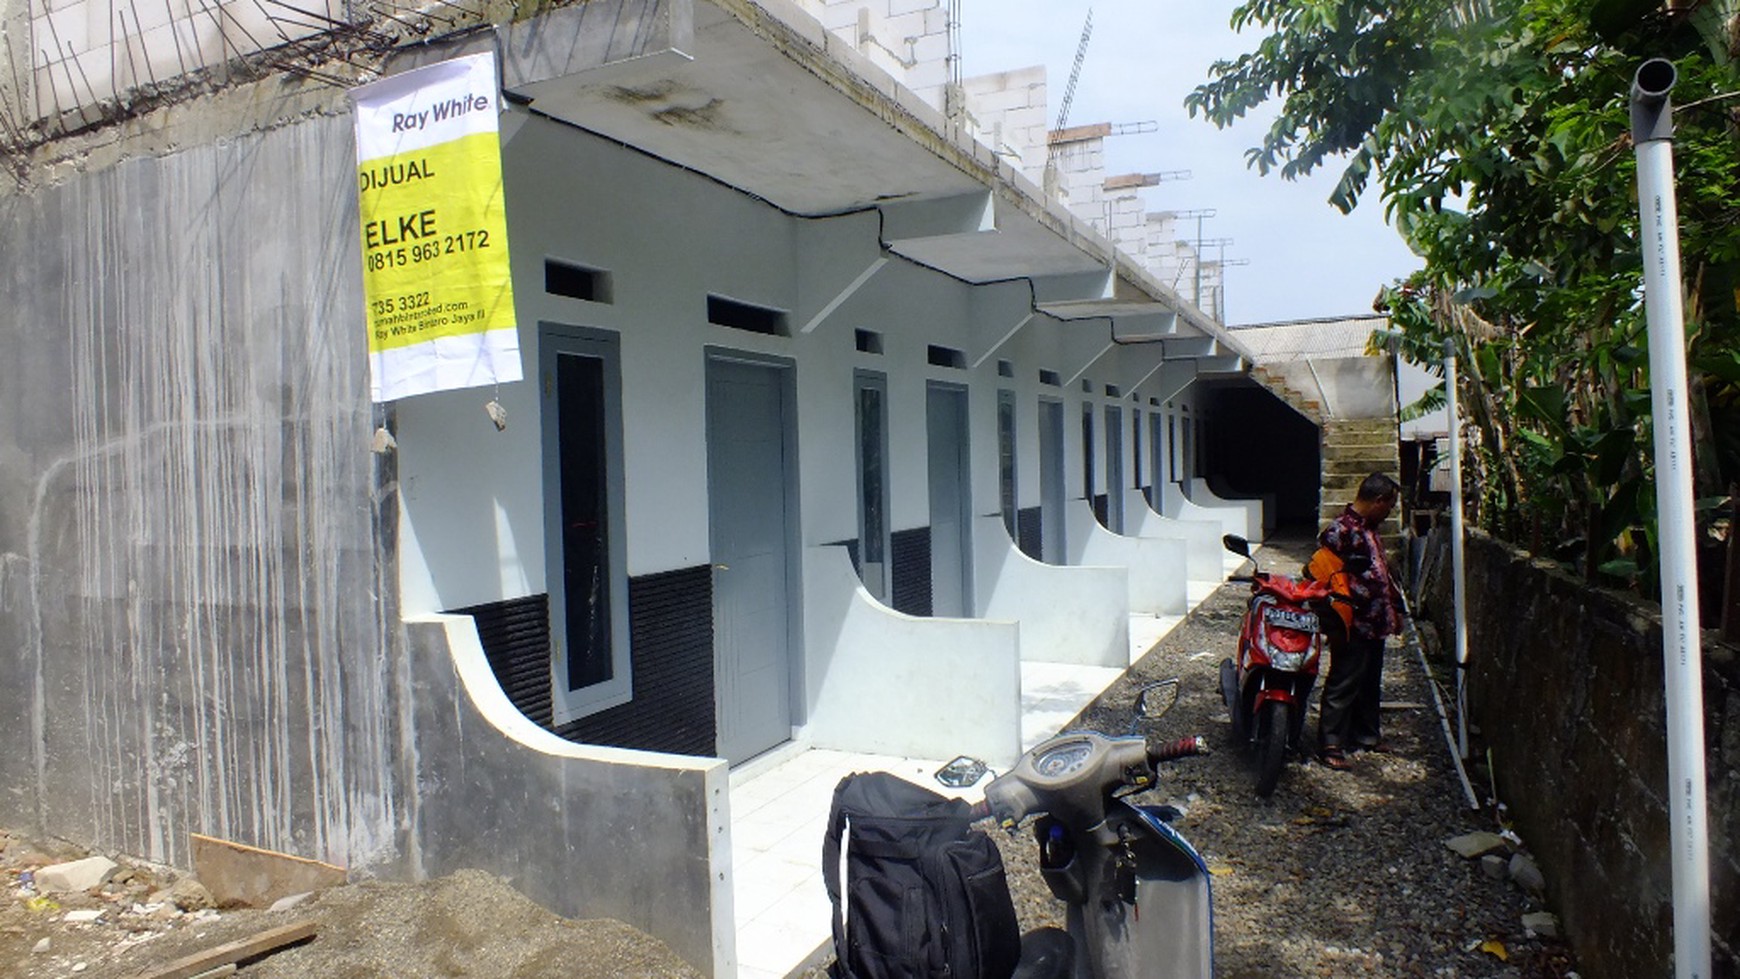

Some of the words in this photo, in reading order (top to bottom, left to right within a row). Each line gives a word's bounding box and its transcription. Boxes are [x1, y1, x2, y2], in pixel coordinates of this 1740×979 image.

[391, 112, 430, 133] Ray
[432, 92, 489, 122] White
[360, 158, 435, 193] DIJUAL
[365, 209, 437, 249] ELKE
[368, 248, 408, 272] 0815
[412, 240, 440, 263] 963
[444, 229, 490, 255] 2172
[398, 291, 430, 311] 3322
[451, 313, 475, 325] Jaya
